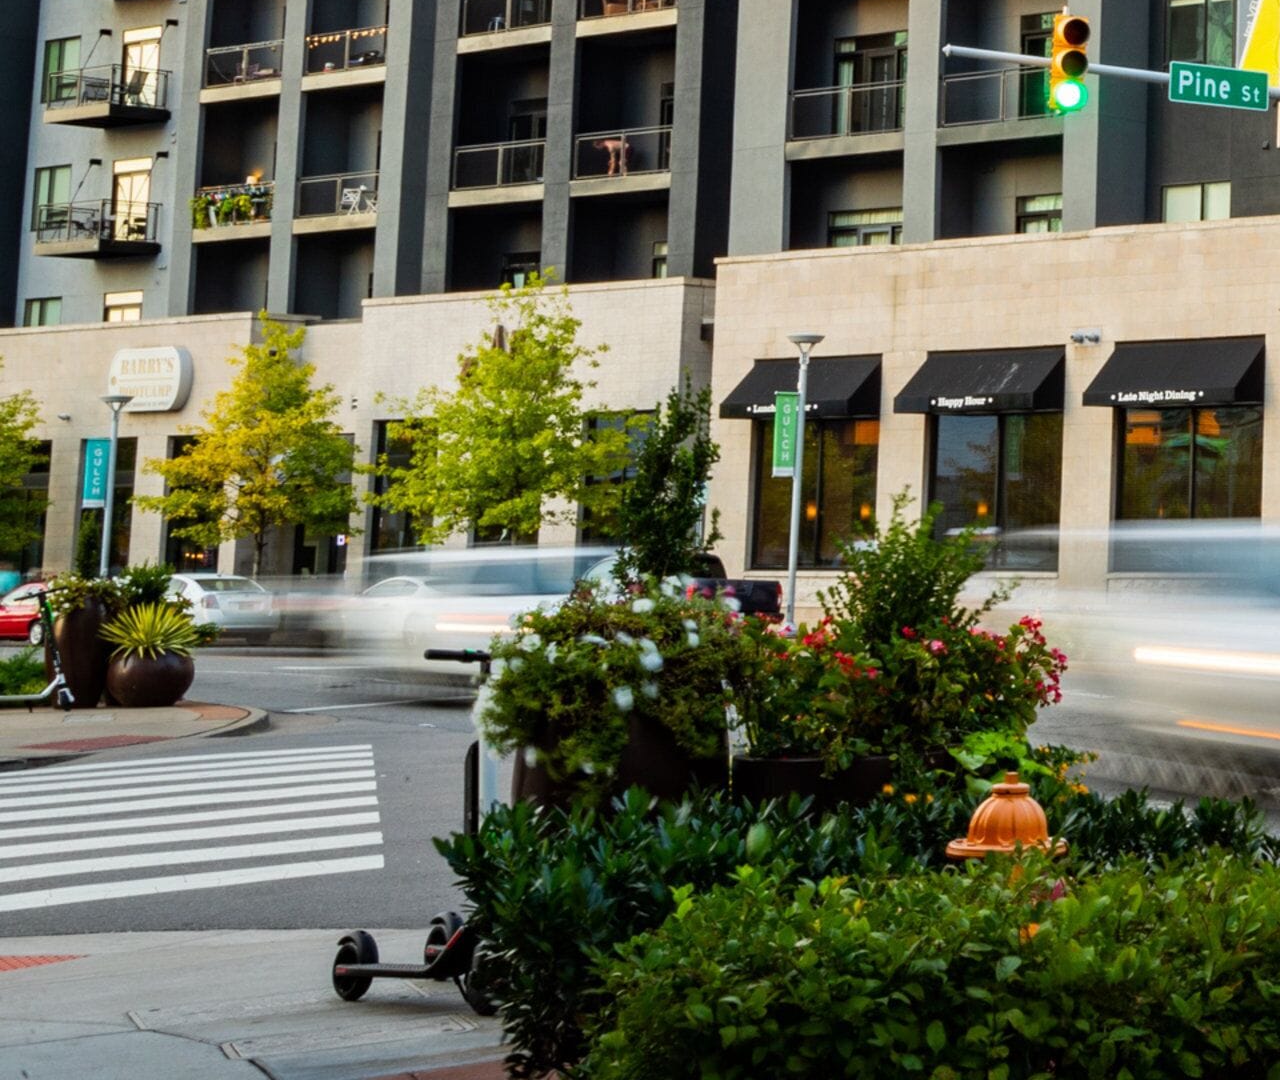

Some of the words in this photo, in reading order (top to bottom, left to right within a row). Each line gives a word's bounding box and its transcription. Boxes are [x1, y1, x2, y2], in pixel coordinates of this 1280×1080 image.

[1178, 70, 1231, 100] Pine
[120, 357, 176, 376] BARRY'S
[937, 396, 964, 409] Happy
[964, 395, 987, 406] Hour
[1117, 392, 1138, 402] Late
[1138, 390, 1164, 403] Night
[1164, 389, 1197, 402] Dining
[781, 403, 793, 462] GULCH
[91, 447, 104, 496] GULCH
